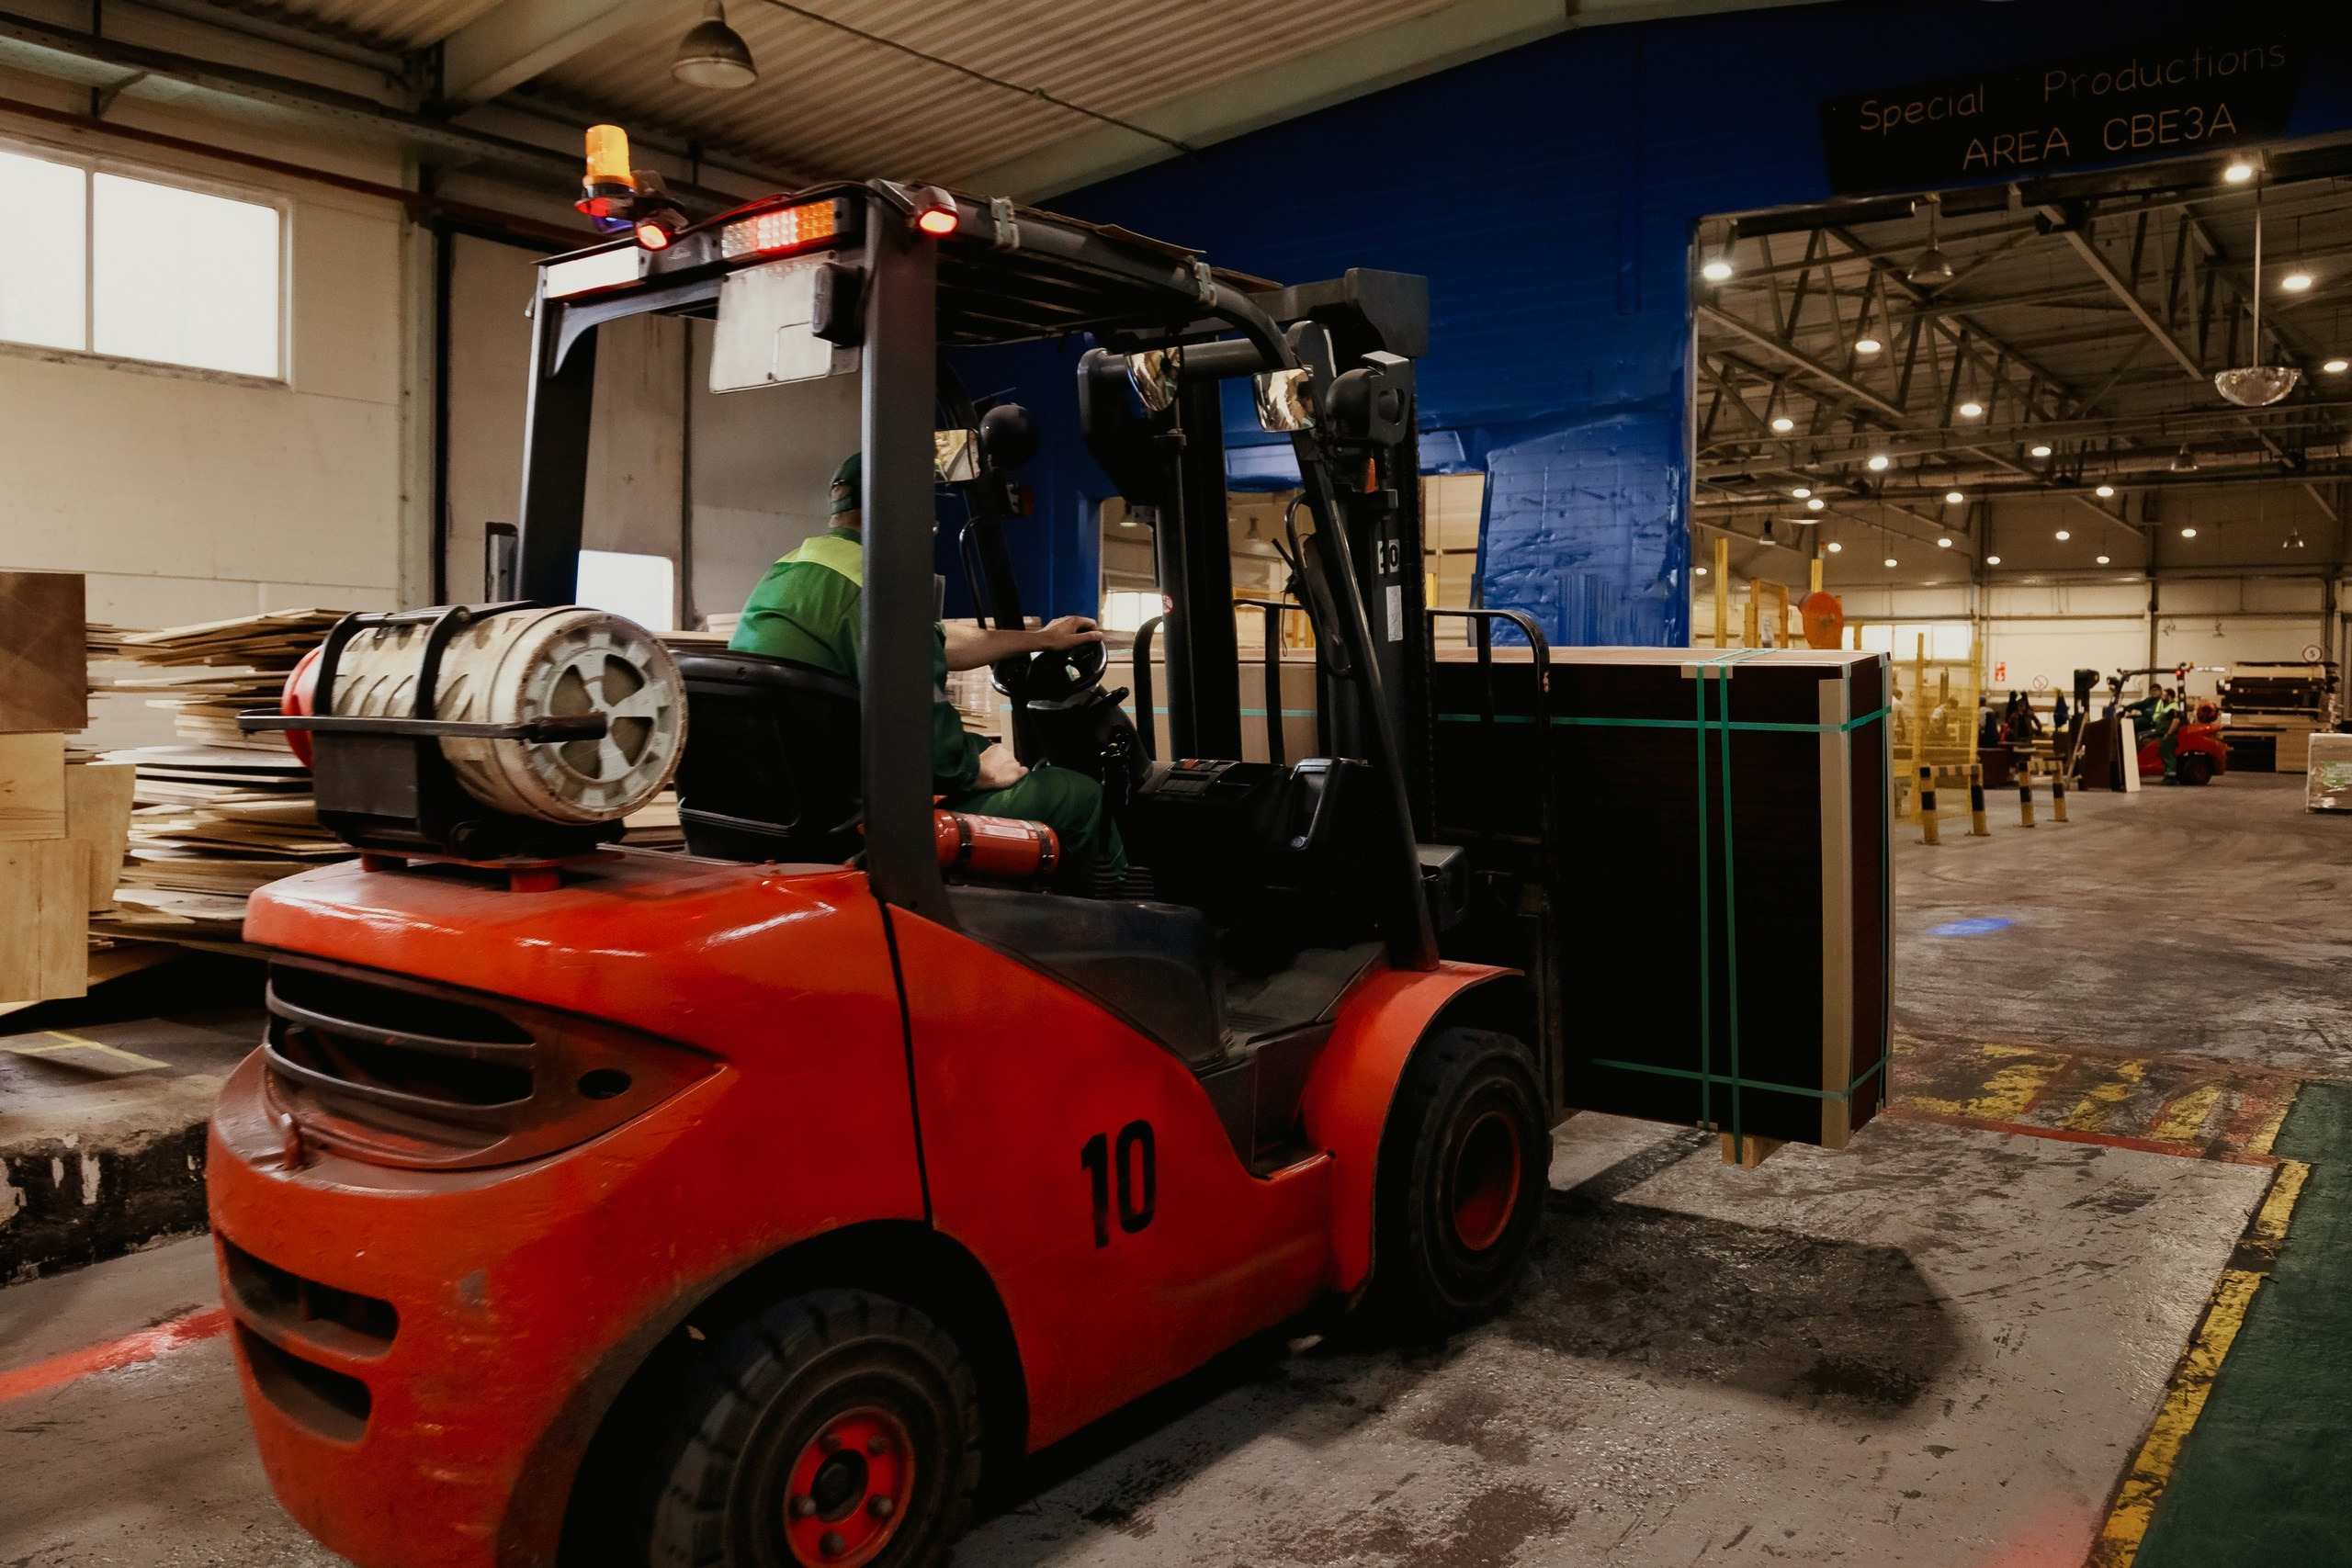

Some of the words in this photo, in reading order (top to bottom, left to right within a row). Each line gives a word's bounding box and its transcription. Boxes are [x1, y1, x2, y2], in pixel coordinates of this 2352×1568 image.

[1859, 84, 1985, 136] Special
[2044, 43, 2286, 103] Productions
[1962, 127, 2071, 171] AREA
[2103, 102, 2238, 152] CBE3A
[1080, 1119, 1157, 1249] 10
